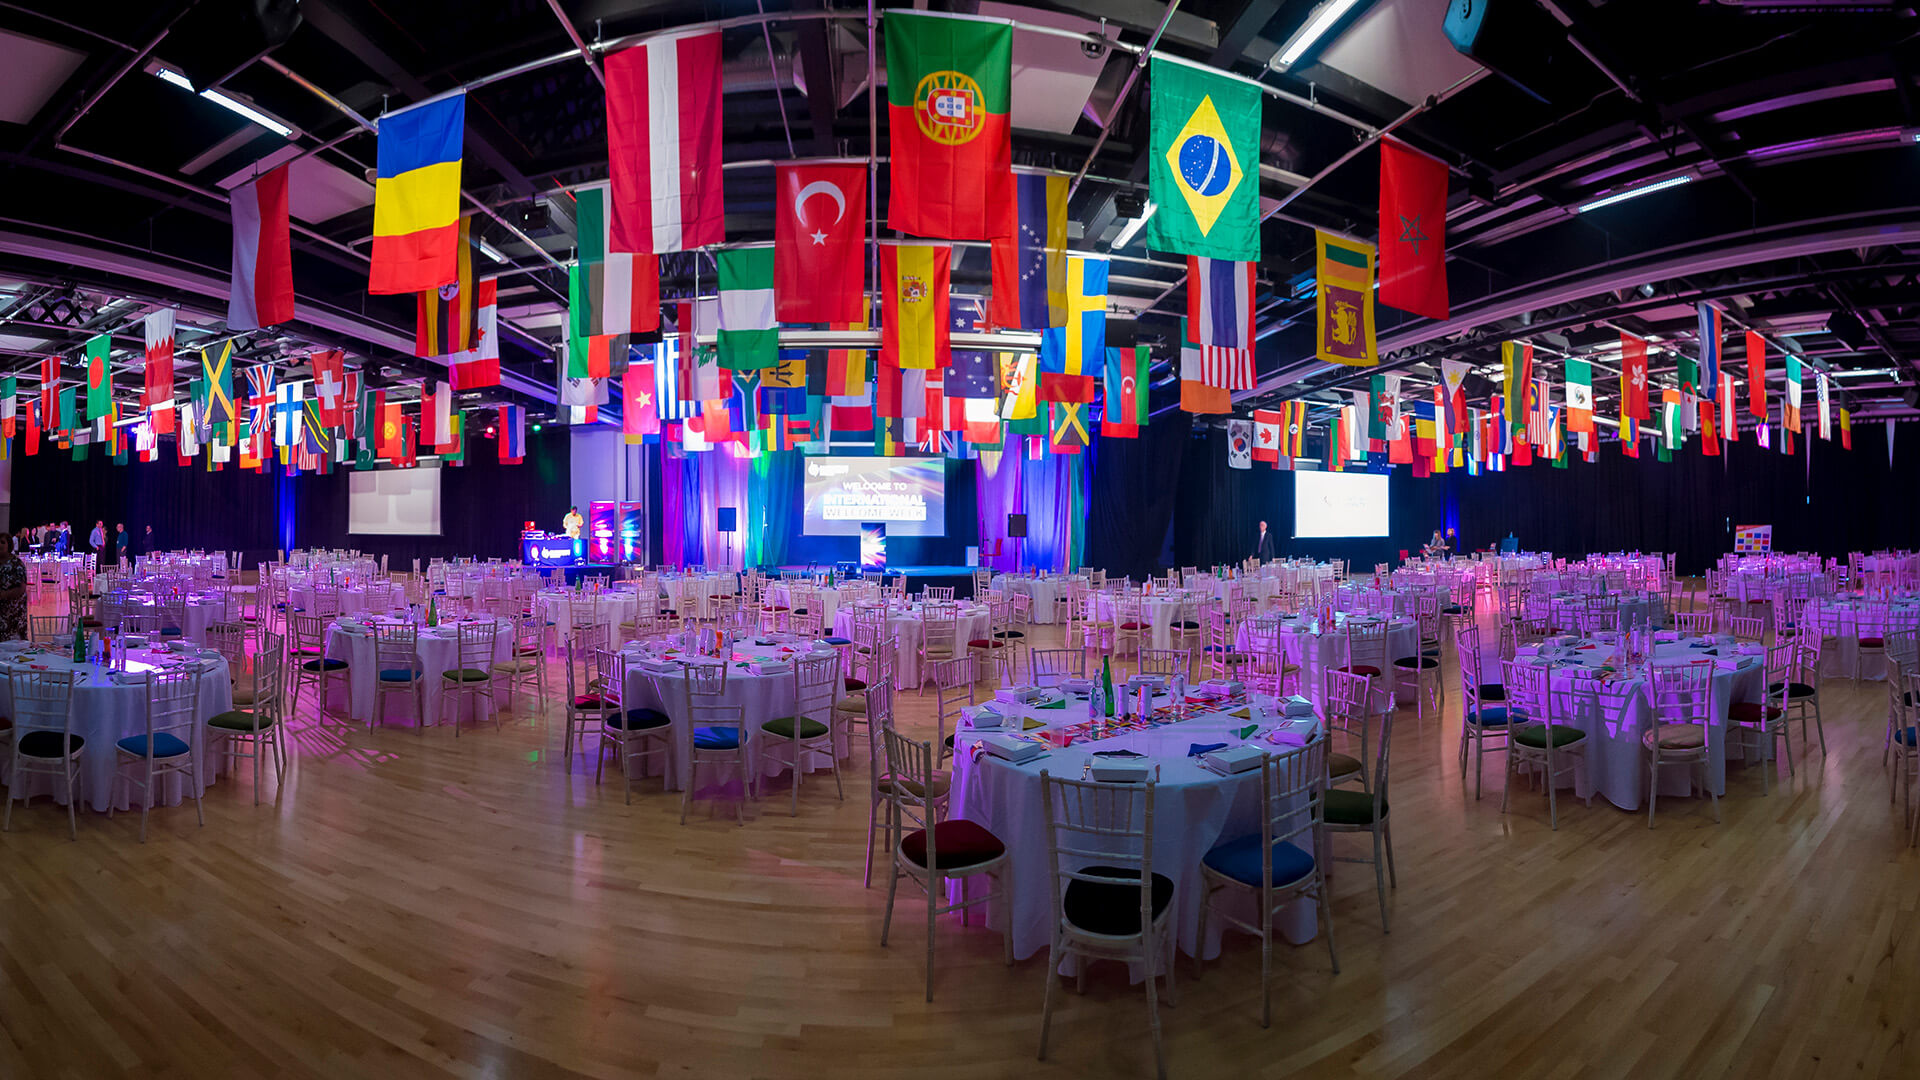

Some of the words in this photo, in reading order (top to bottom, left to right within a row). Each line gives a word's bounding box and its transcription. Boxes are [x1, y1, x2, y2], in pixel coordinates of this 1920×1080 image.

[843, 482, 891, 491] WELCOME
[894, 482, 907, 490] TO
[824, 494, 926, 506] INTERNATIONAL
[826, 509, 883, 517] WELCOME
[889, 509, 923, 517] WEEK
